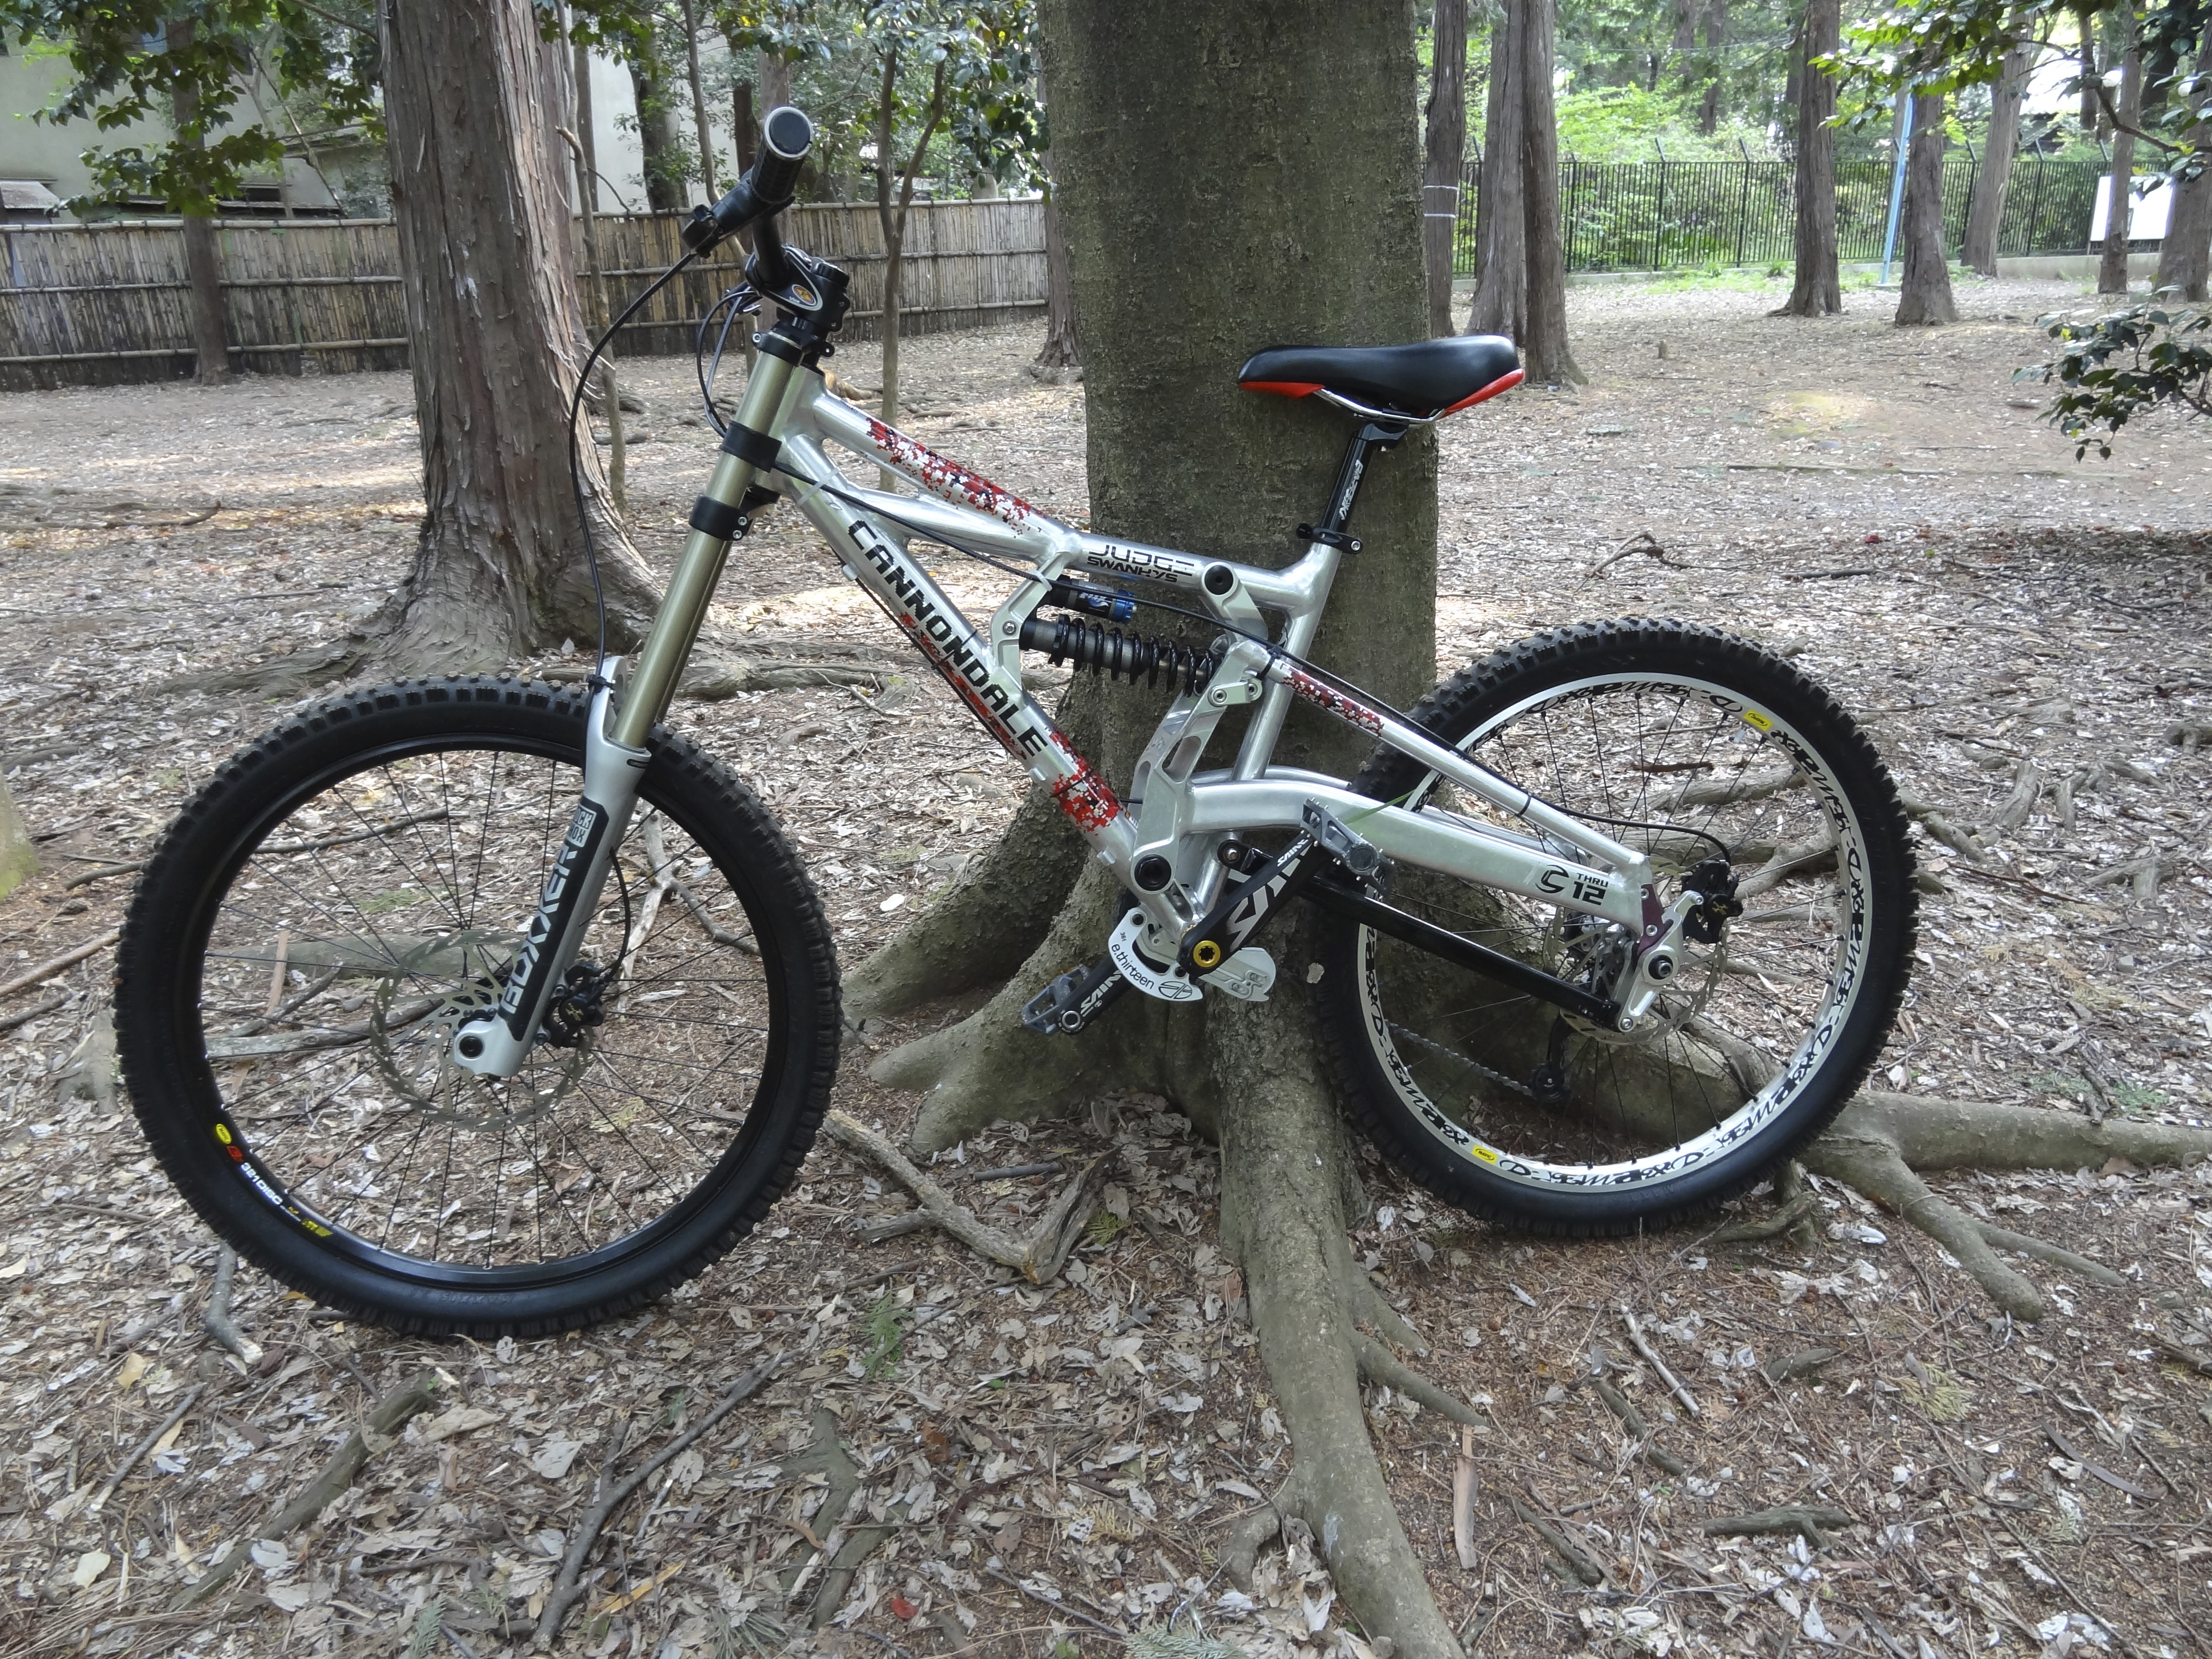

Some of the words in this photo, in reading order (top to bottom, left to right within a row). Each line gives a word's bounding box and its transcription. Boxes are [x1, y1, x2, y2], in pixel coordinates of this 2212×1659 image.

[1088, 544, 1194, 577] JUDGE
[848, 520, 1048, 757] CANNONDALE
[1572, 881, 1607, 906] 12
[1576, 872, 1609, 889] THRU
[500, 843, 578, 1014] BOXXER
[1111, 943, 1154, 990] e.thirteen
